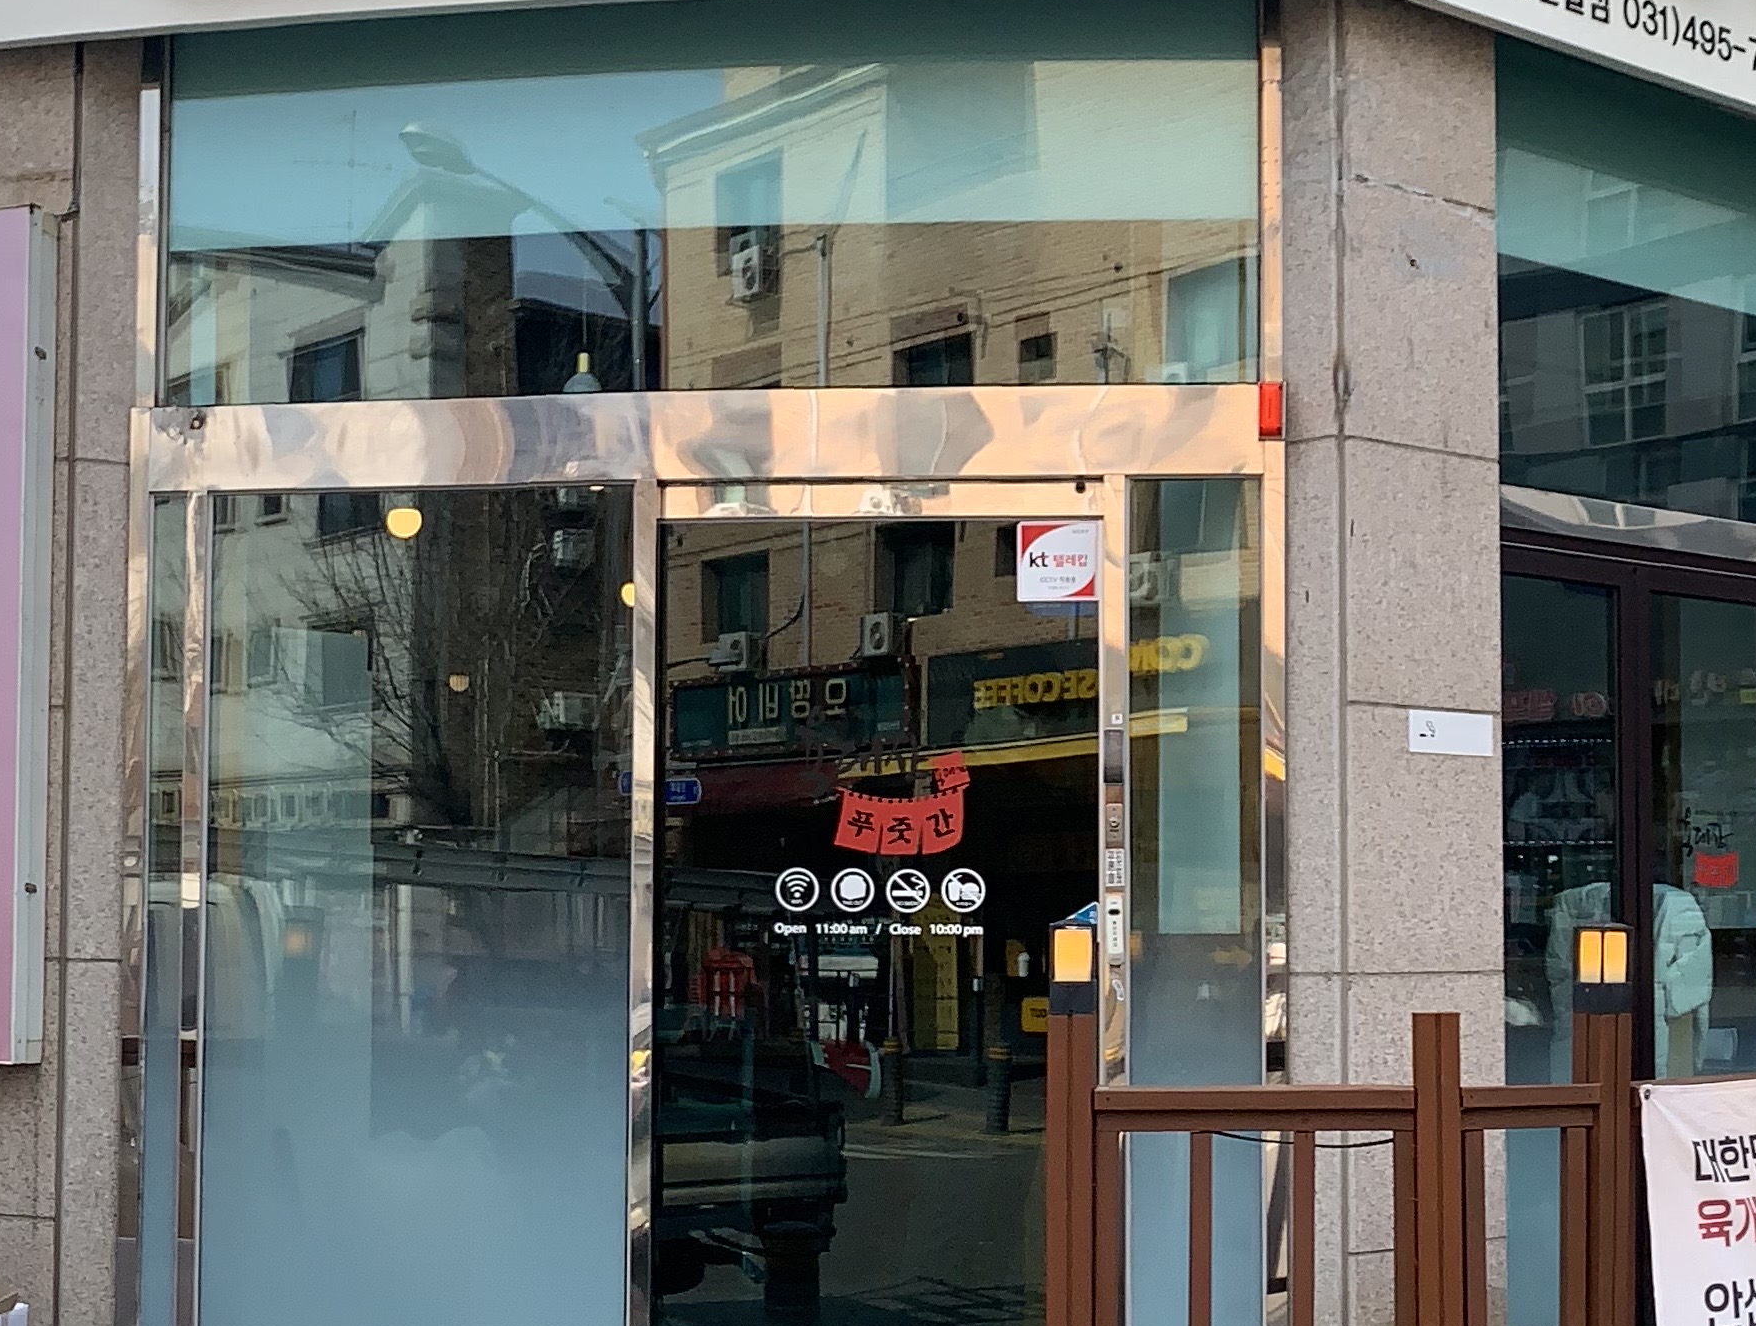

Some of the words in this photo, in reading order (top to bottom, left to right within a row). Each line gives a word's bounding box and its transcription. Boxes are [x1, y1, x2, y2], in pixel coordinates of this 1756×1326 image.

[1028, 551, 1049, 568] kt
[847, 806, 958, 847] 푸줏간
[773, 922, 808, 936] Open
[889, 922, 923, 936] Close
